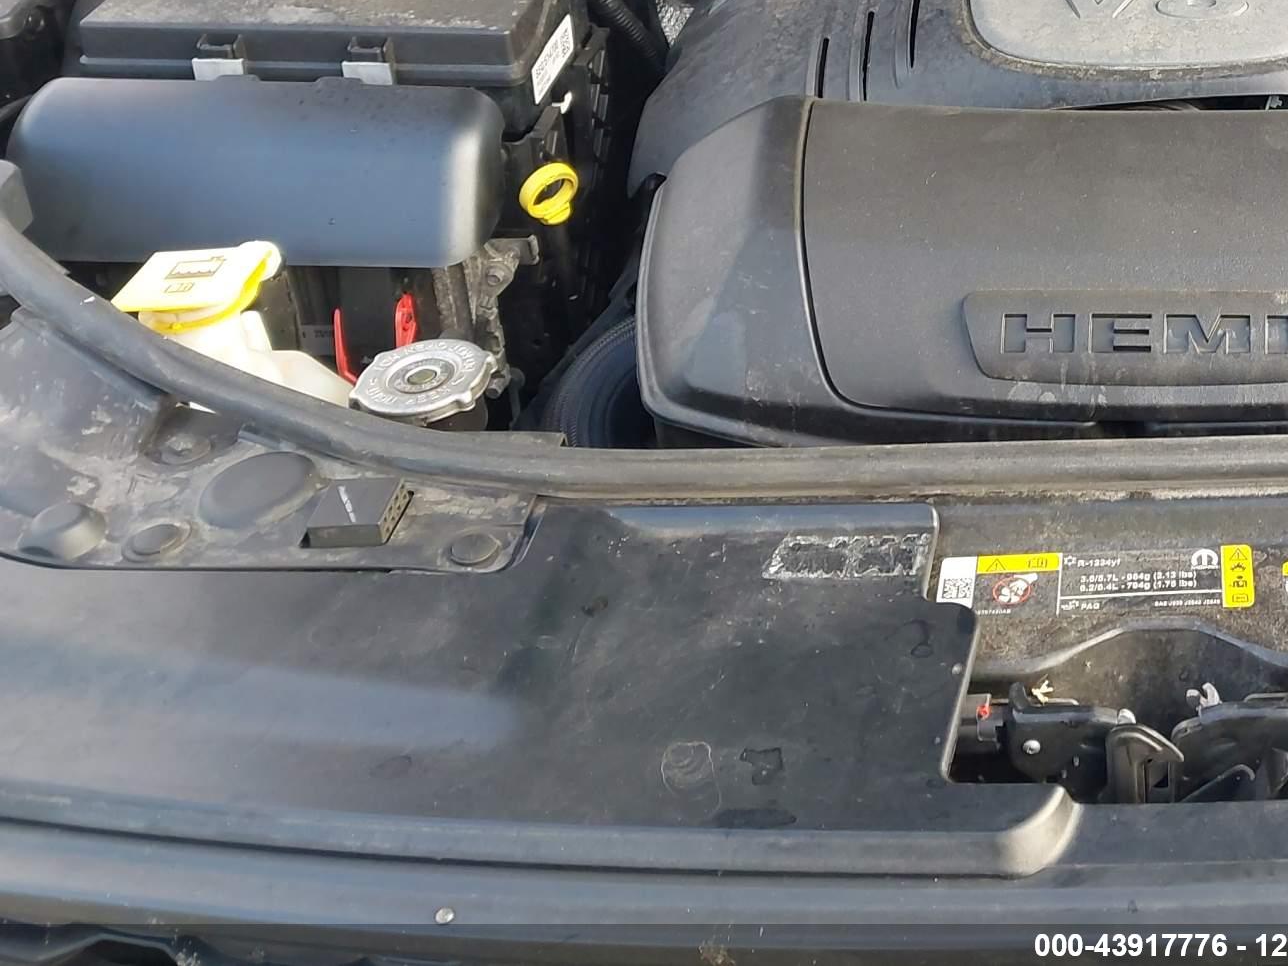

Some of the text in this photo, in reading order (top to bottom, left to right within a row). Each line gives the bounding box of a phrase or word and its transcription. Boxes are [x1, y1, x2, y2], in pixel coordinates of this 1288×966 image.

[1077, 557, 1121, 567] R-1234yf
[1178, 570, 1197, 580] lbs)
[1178, 579, 1197, 589] lbs)
